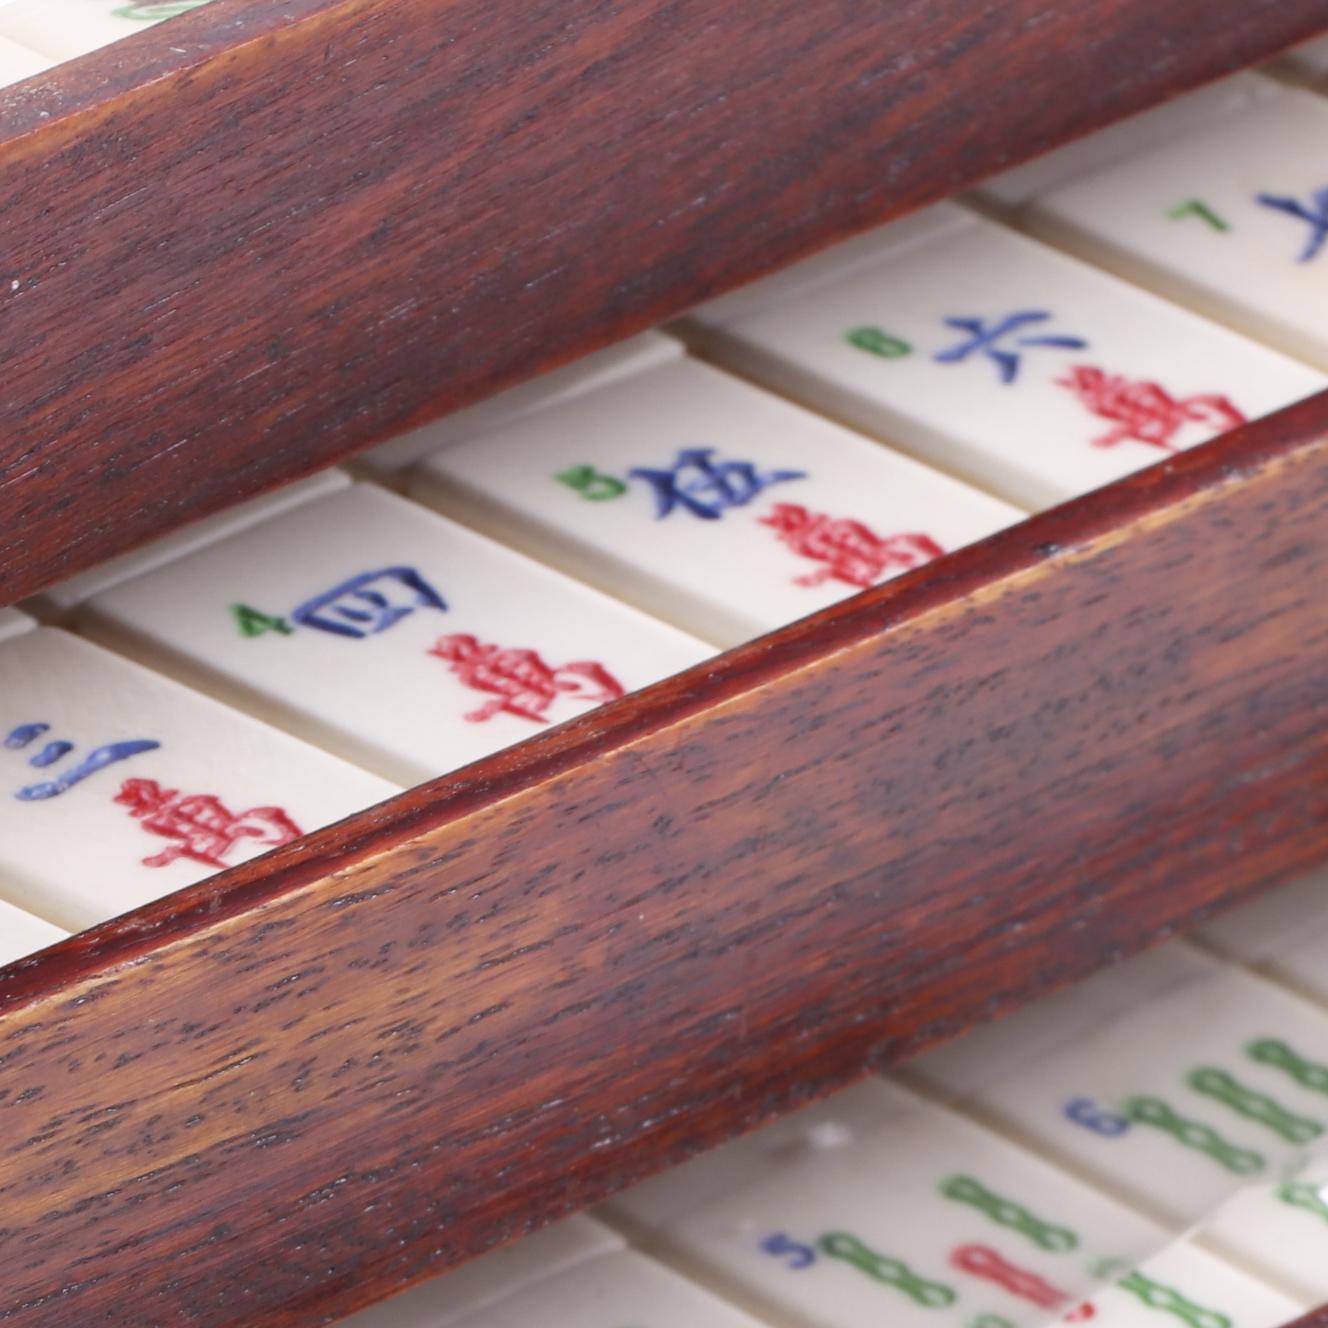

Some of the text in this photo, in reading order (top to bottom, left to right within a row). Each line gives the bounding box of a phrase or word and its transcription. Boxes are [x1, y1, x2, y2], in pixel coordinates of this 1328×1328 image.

[553, 465, 626, 502] 5
[231, 603, 290, 637] 4
[1066, 1097, 1128, 1139] 6
[758, 1231, 819, 1271] 5
